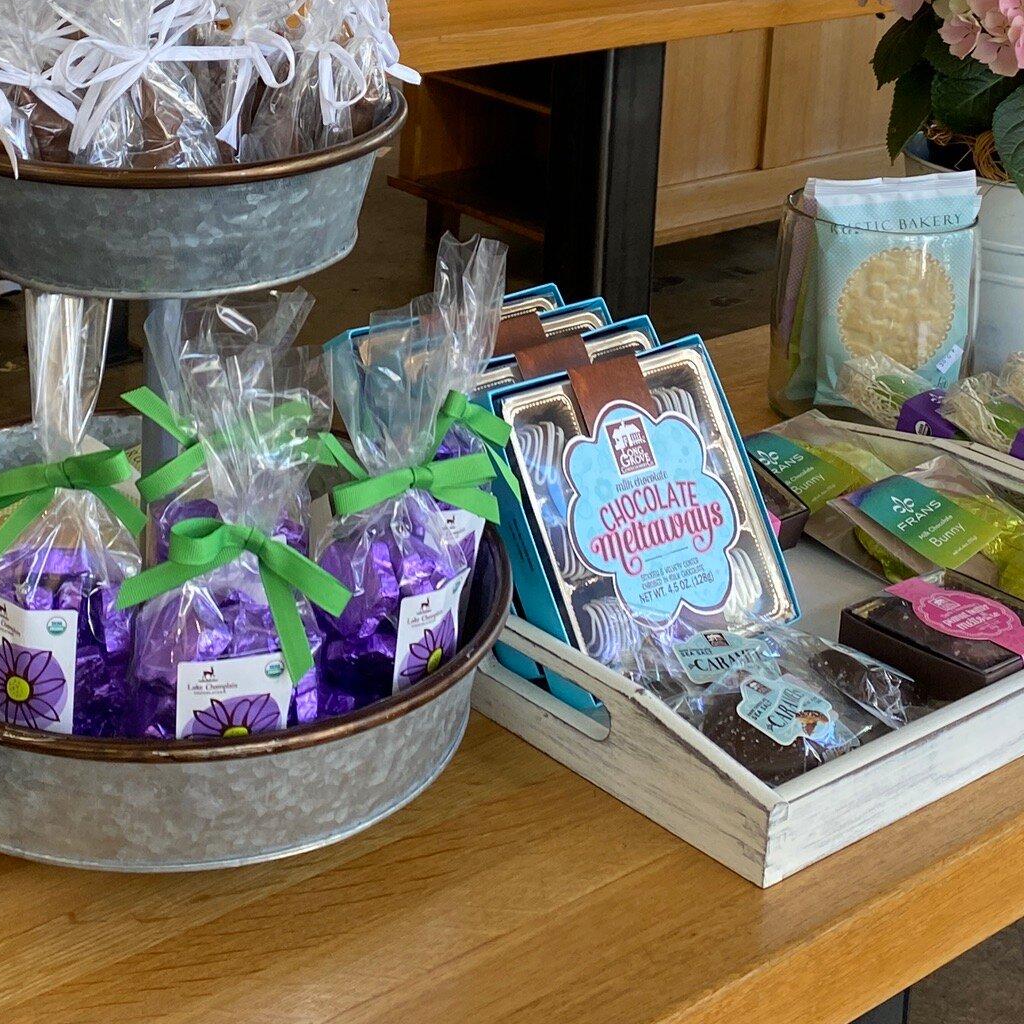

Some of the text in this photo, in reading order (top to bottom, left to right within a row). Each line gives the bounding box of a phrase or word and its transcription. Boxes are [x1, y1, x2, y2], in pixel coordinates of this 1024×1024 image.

[898, 213, 962, 231] BAKERY
[620, 452, 652, 468] GROVE
[621, 445, 645, 458] LONG
[772, 453, 804, 476] RANS
[616, 469, 669, 493] milk chocolate
[791, 473, 826, 496] Bunny
[599, 481, 700, 531] CHOCOLATE
[897, 499, 941, 532] FRANS
[928, 514, 953, 533] Chocolate
[929, 522, 966, 548] Bunny
[590, 501, 724, 576] meltaways
[638, 570, 715, 604] NET WT. 4.5 OZ. (128g)
[205, 682, 238, 694] Champlain
[751, 698, 773, 720] SEA SALT
[767, 687, 805, 729] CARAMEL
